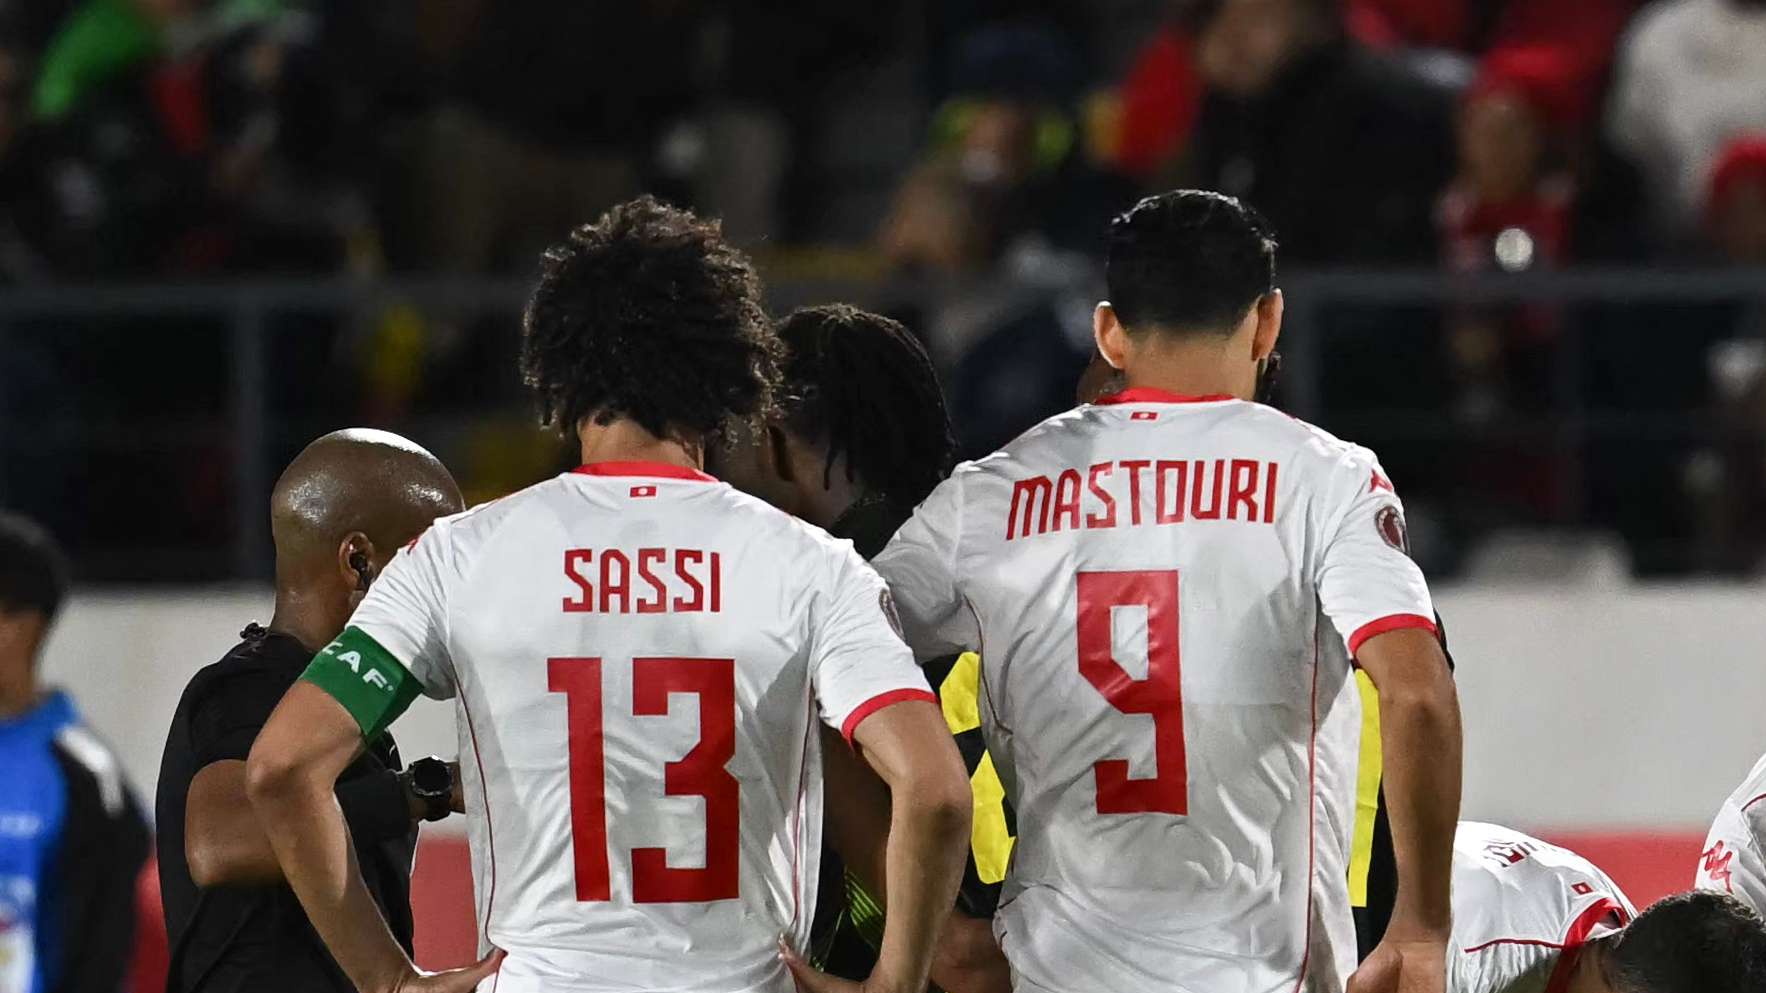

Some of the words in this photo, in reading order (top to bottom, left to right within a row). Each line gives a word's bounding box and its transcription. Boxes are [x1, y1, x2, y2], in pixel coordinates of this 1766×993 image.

[562, 547, 722, 614] SASSI
[1006, 459, 1278, 541] MASTOURI
[1076, 570, 1188, 815] 9
[547, 657, 740, 904] 13
